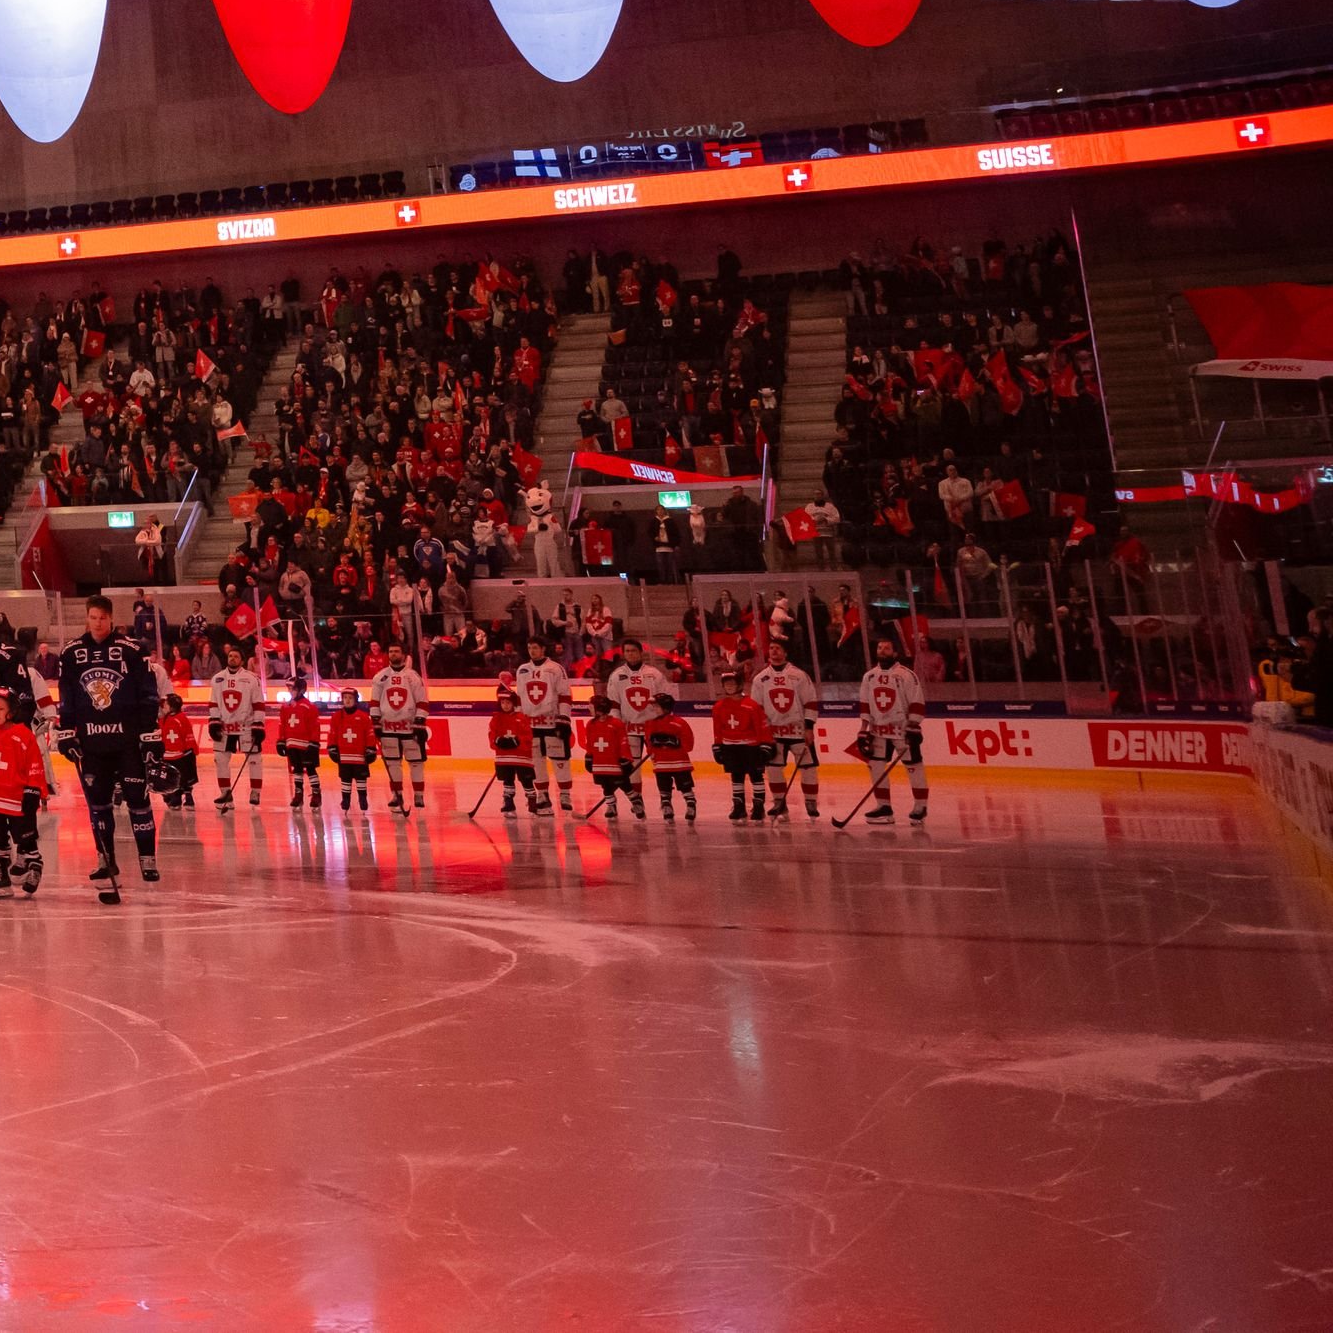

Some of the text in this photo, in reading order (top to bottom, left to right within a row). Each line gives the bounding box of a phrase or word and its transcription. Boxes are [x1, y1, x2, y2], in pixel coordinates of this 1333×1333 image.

[977, 143, 1055, 171] SUISSE
[553, 182, 637, 210] SCHWEIZ
[217, 217, 276, 242] SVIZRA
[1258, 363, 1303, 372] SWISS
[83, 671, 115, 680] SUOMI
[120, 660, 128, 674] A
[945, 721, 1034, 764] kpt:
[1107, 729, 1209, 764] DENNER
